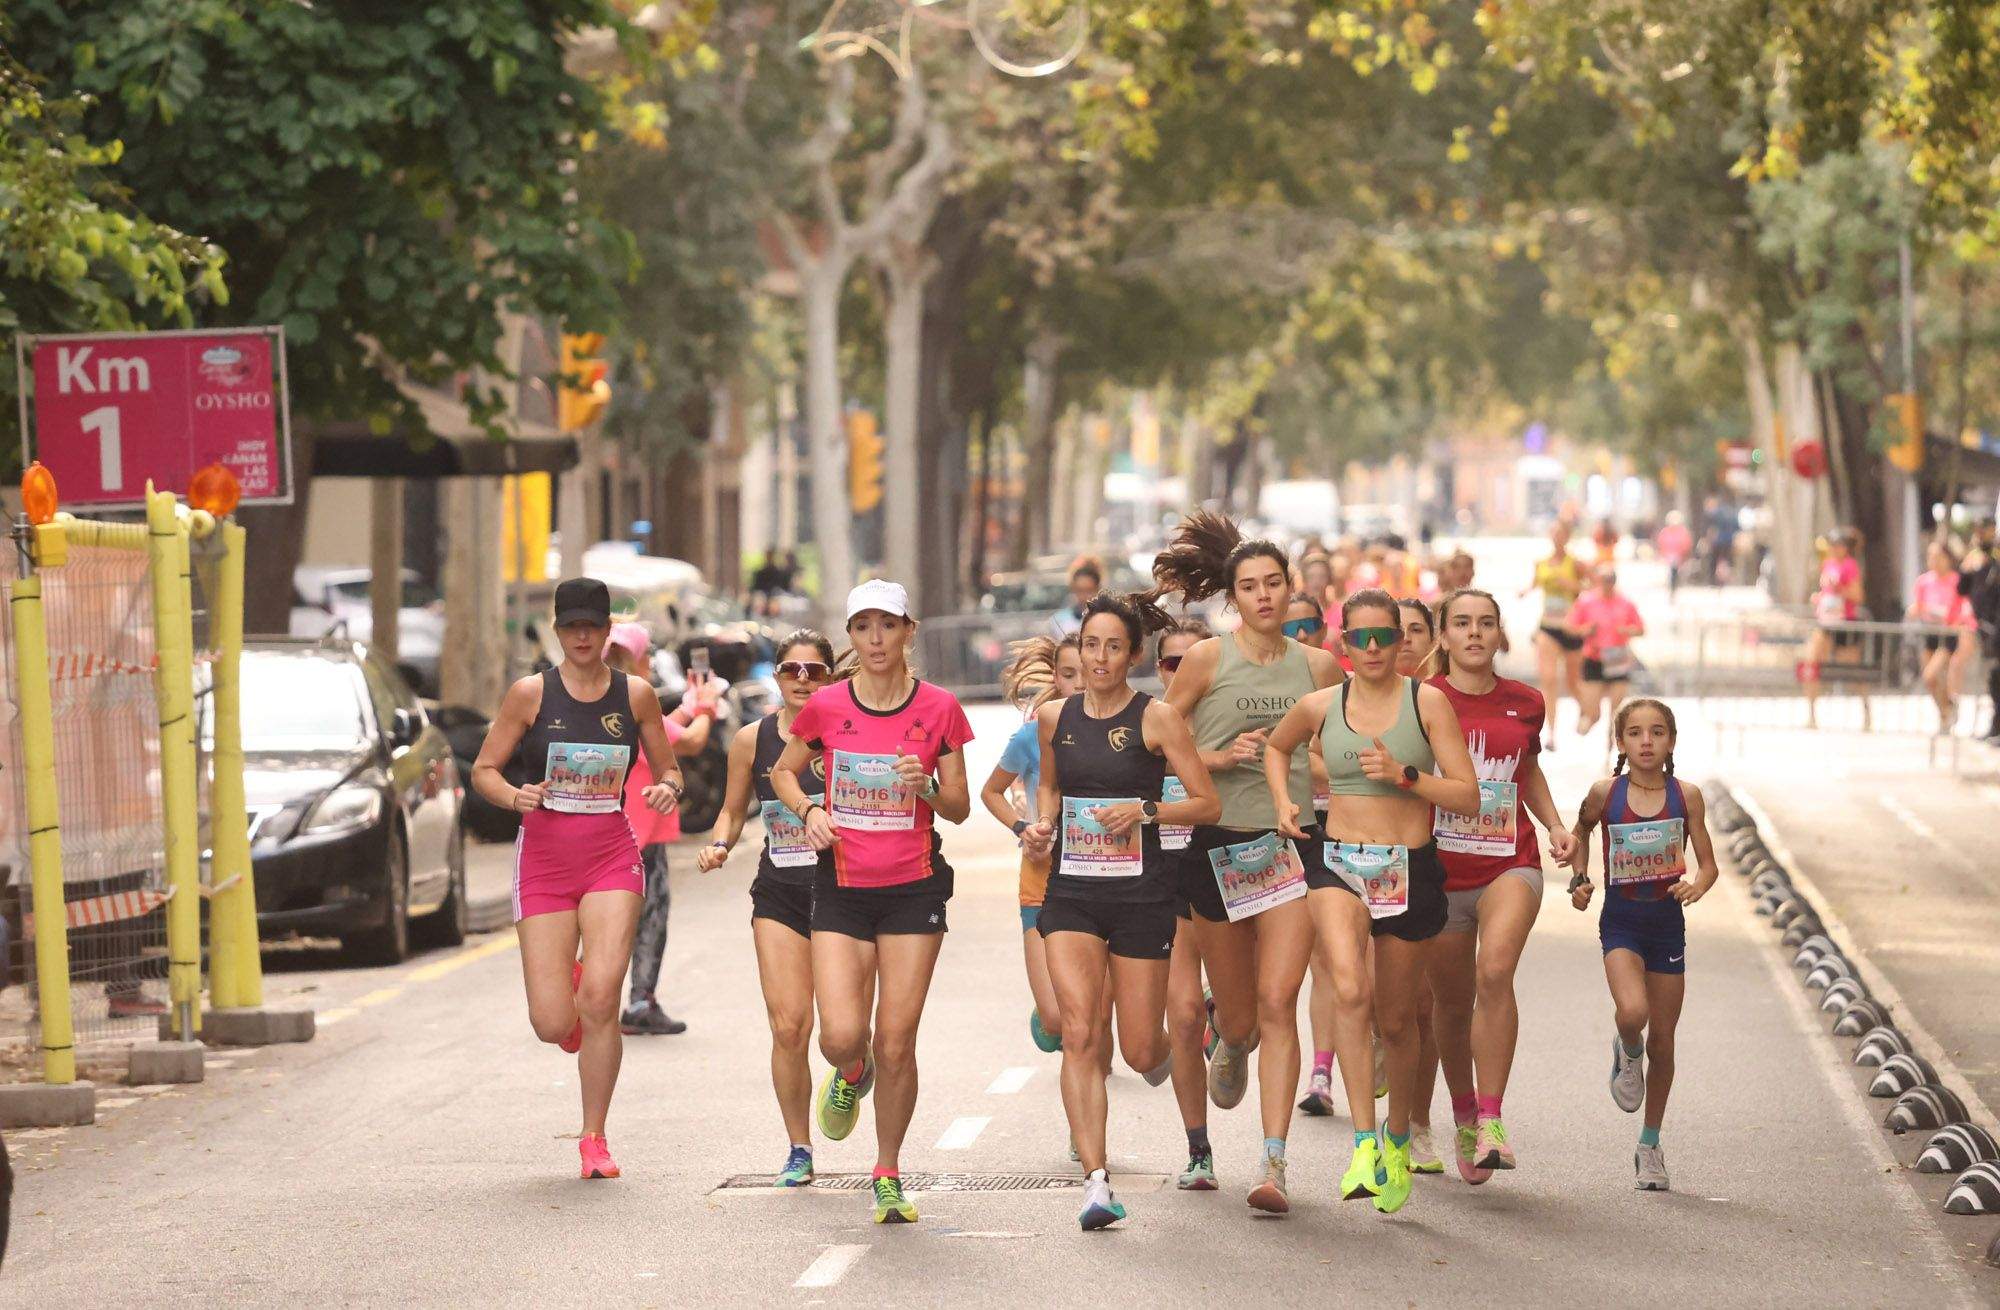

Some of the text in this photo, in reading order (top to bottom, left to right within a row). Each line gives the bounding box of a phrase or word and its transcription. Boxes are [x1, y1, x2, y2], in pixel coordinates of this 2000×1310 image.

[57, 346, 150, 394] Km
[195, 391, 271, 410] OYSHO
[80, 405, 123, 491] 1
[1236, 696, 1296, 711] OYSHO
[573, 773, 600, 786] 016
[857, 787, 889, 800] 016
[1084, 832, 1114, 846] 016
[1634, 853, 1664, 868] 016
